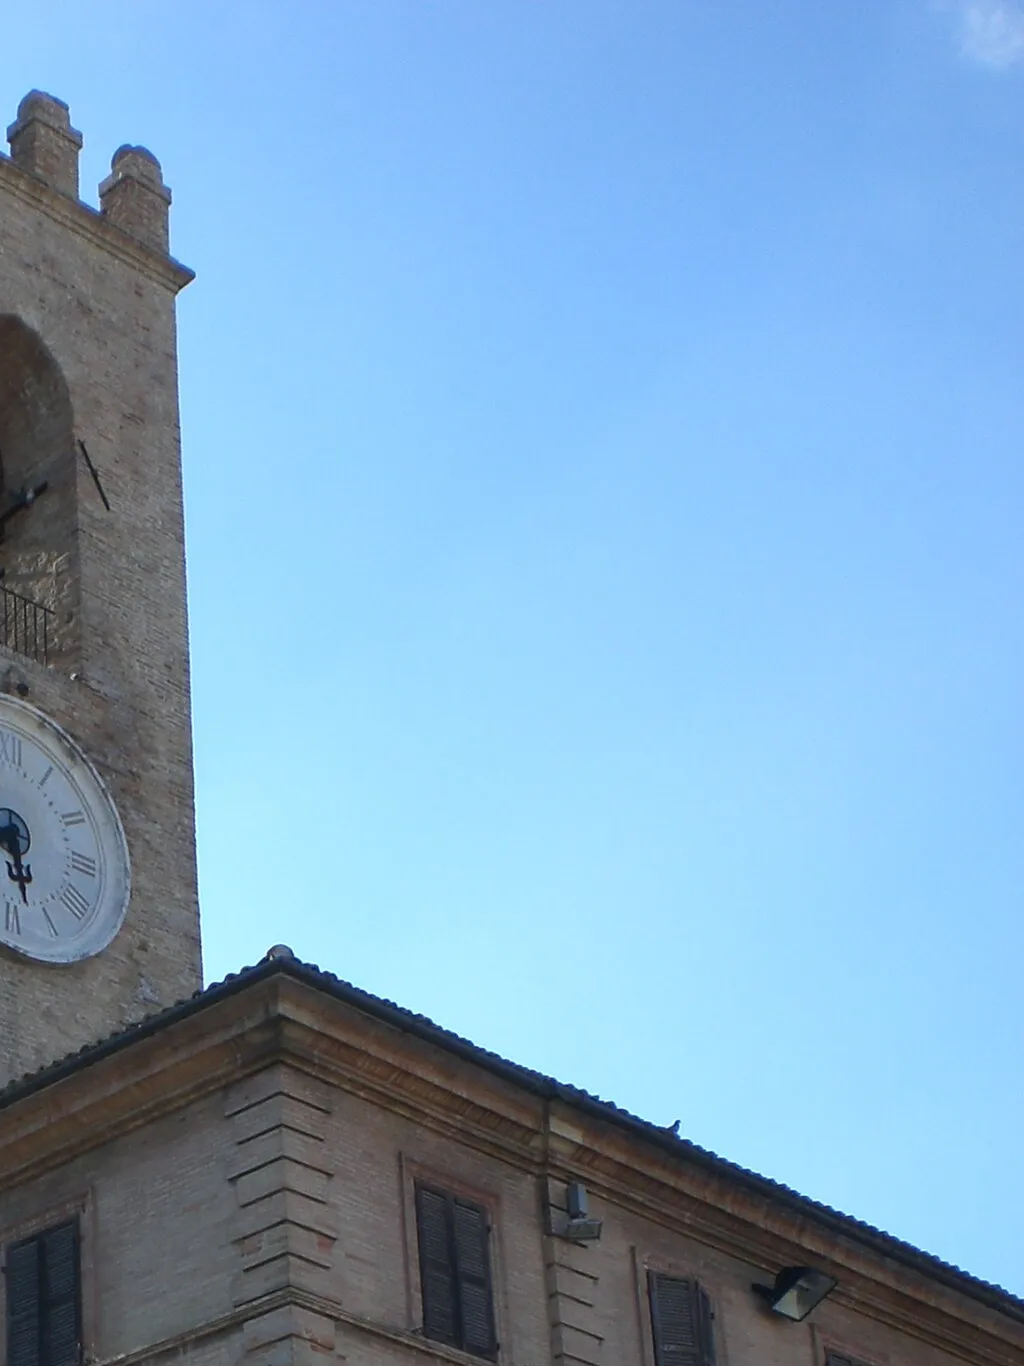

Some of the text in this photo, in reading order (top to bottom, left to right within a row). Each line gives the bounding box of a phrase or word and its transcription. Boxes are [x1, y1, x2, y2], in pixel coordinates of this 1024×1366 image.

[38, 765, 54, 787] I
[61, 810, 86, 827] II
[71, 850, 97, 879] III
[59, 882, 90, 921] IIII
